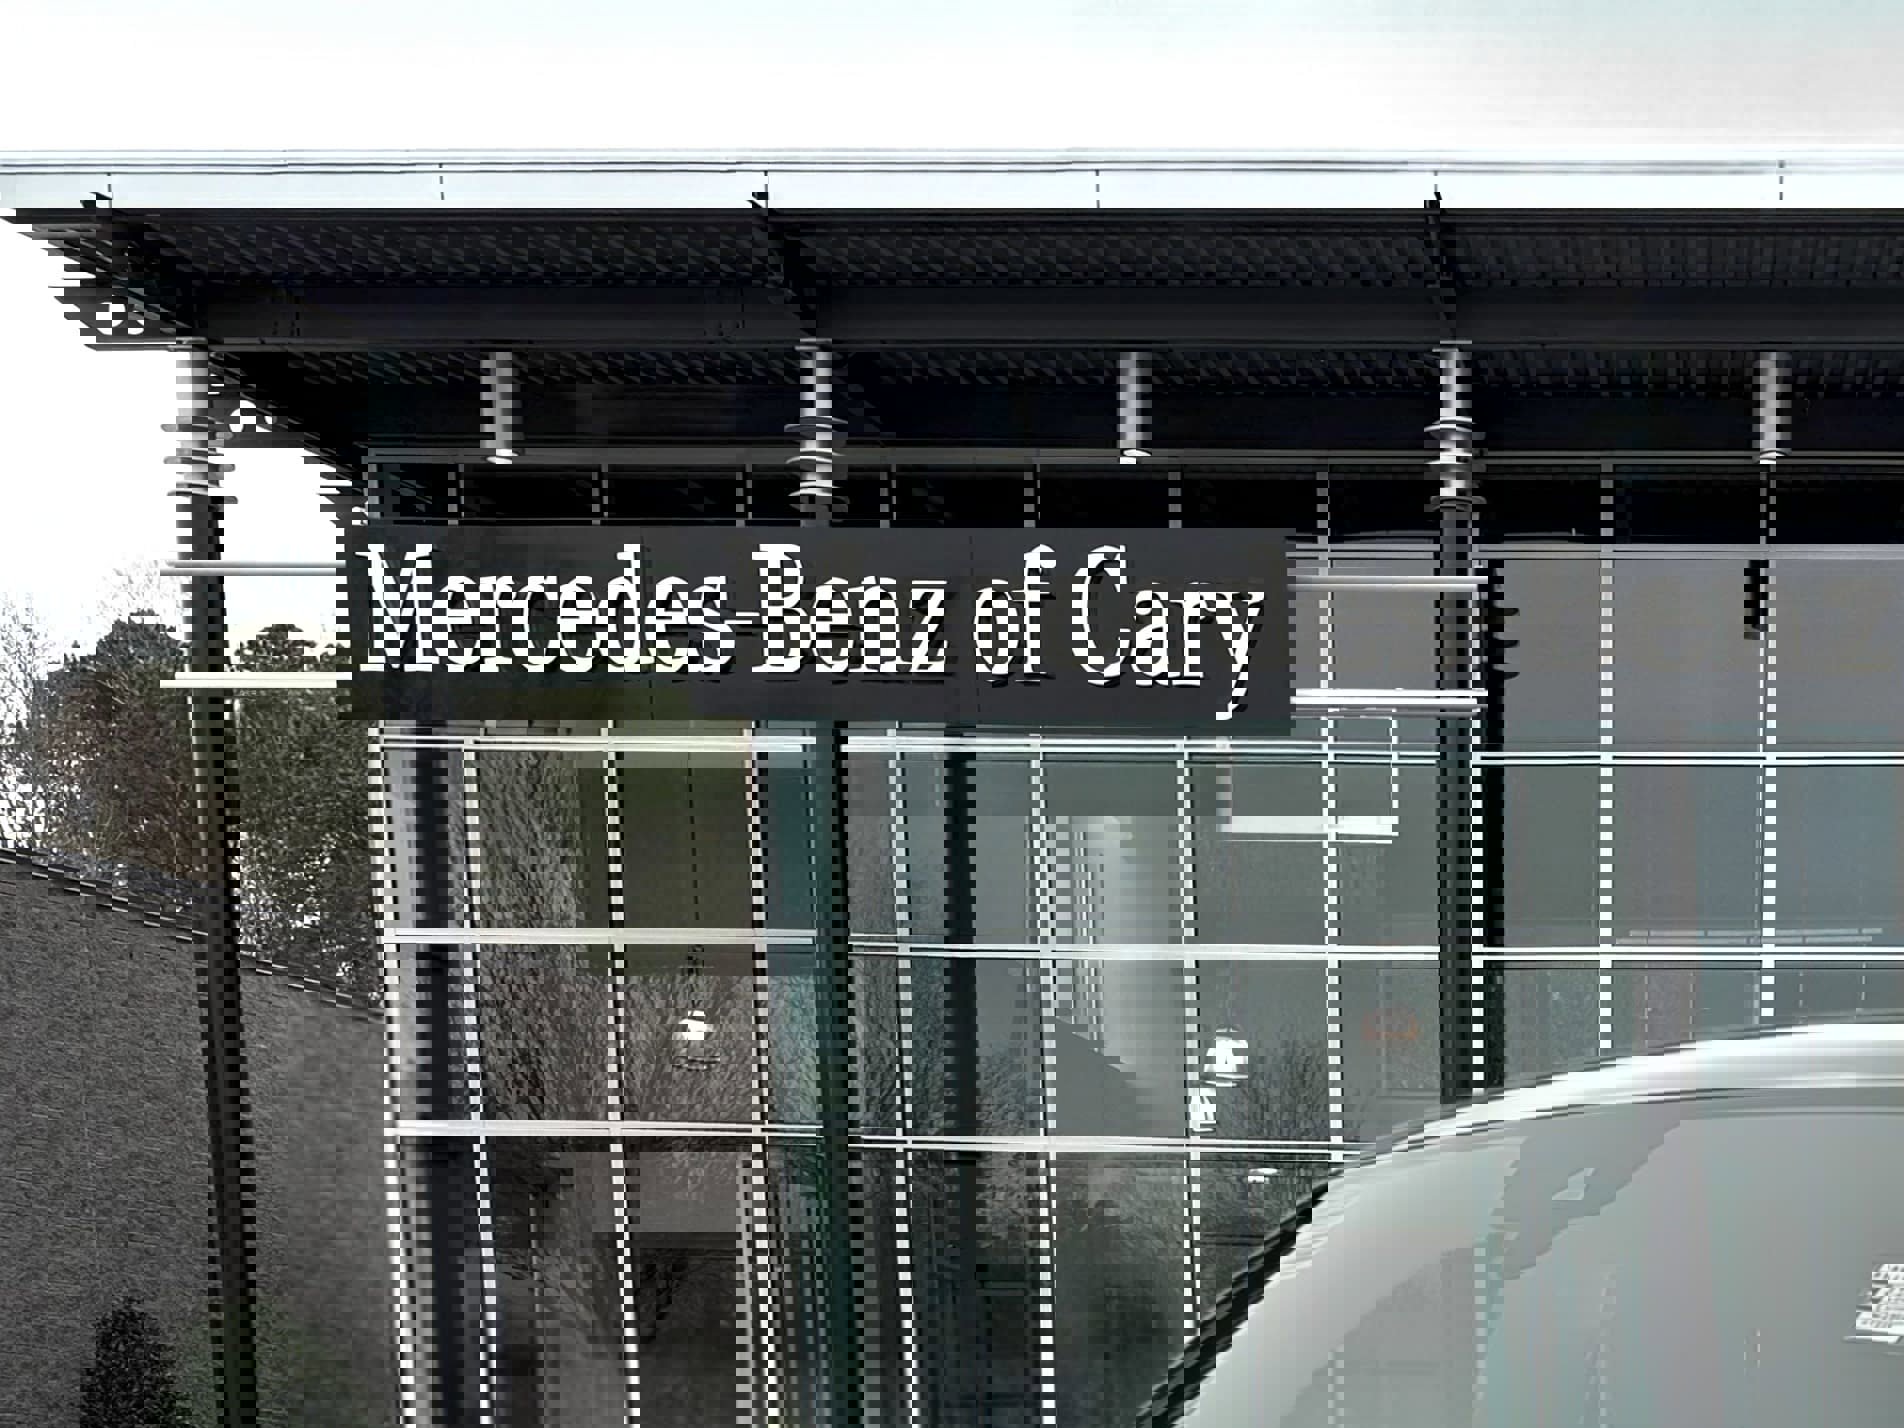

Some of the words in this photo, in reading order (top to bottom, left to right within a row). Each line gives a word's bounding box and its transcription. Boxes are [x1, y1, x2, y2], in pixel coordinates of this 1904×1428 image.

[354, 543, 946, 674] Mercedes-Benz
[972, 544, 1057, 675] of
[1071, 544, 1265, 720] Cary
